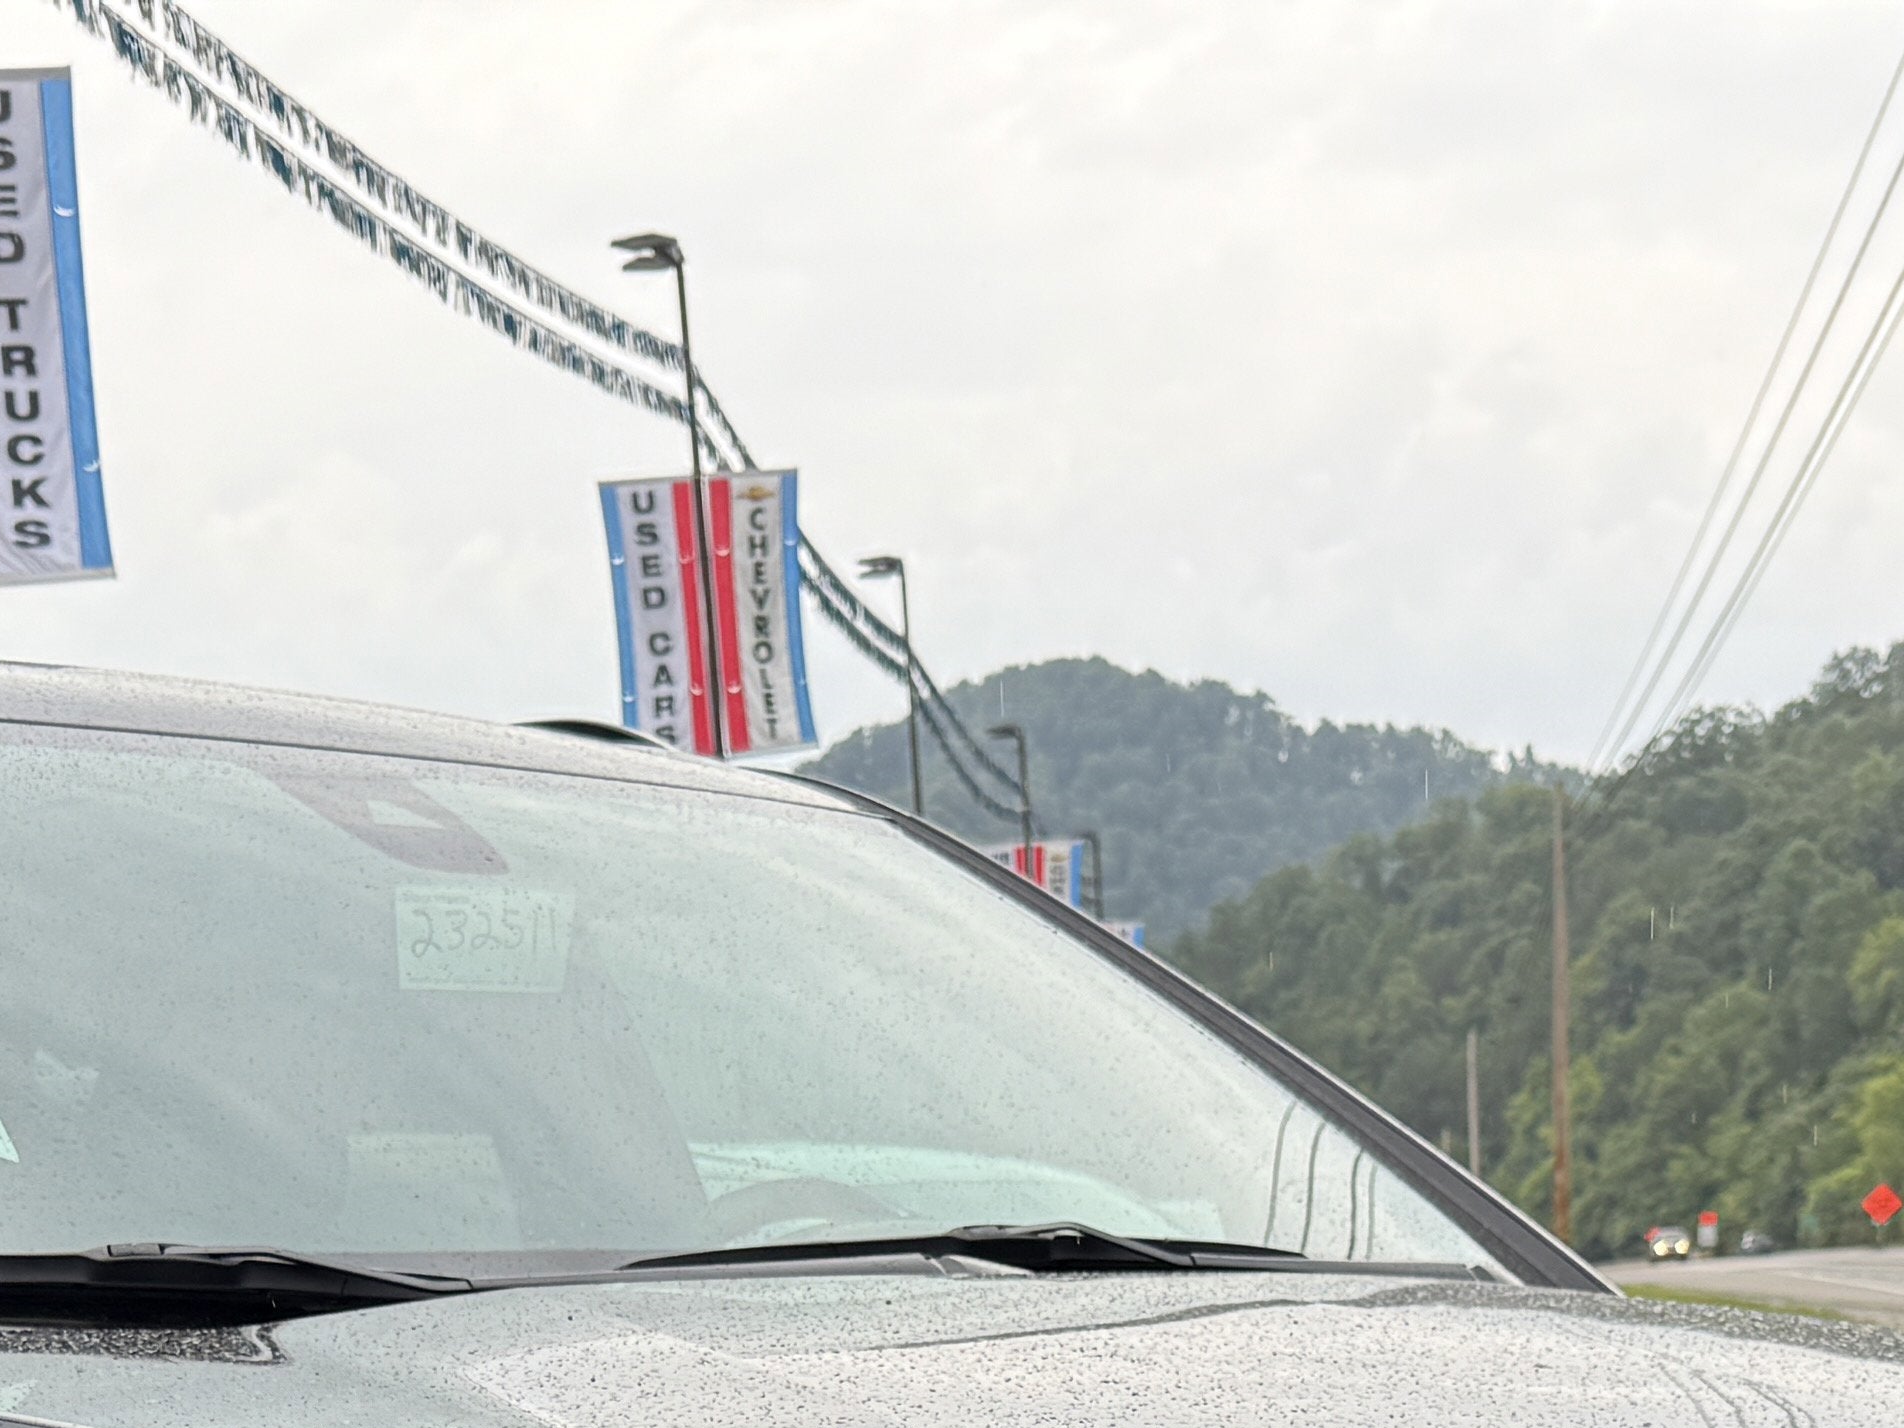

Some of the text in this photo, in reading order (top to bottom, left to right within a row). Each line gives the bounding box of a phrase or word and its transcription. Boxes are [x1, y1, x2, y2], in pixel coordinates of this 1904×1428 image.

[631, 490, 676, 745] USED CARS
[748, 508, 780, 741] CHEVROLET
[411, 907, 557, 958] 232511
